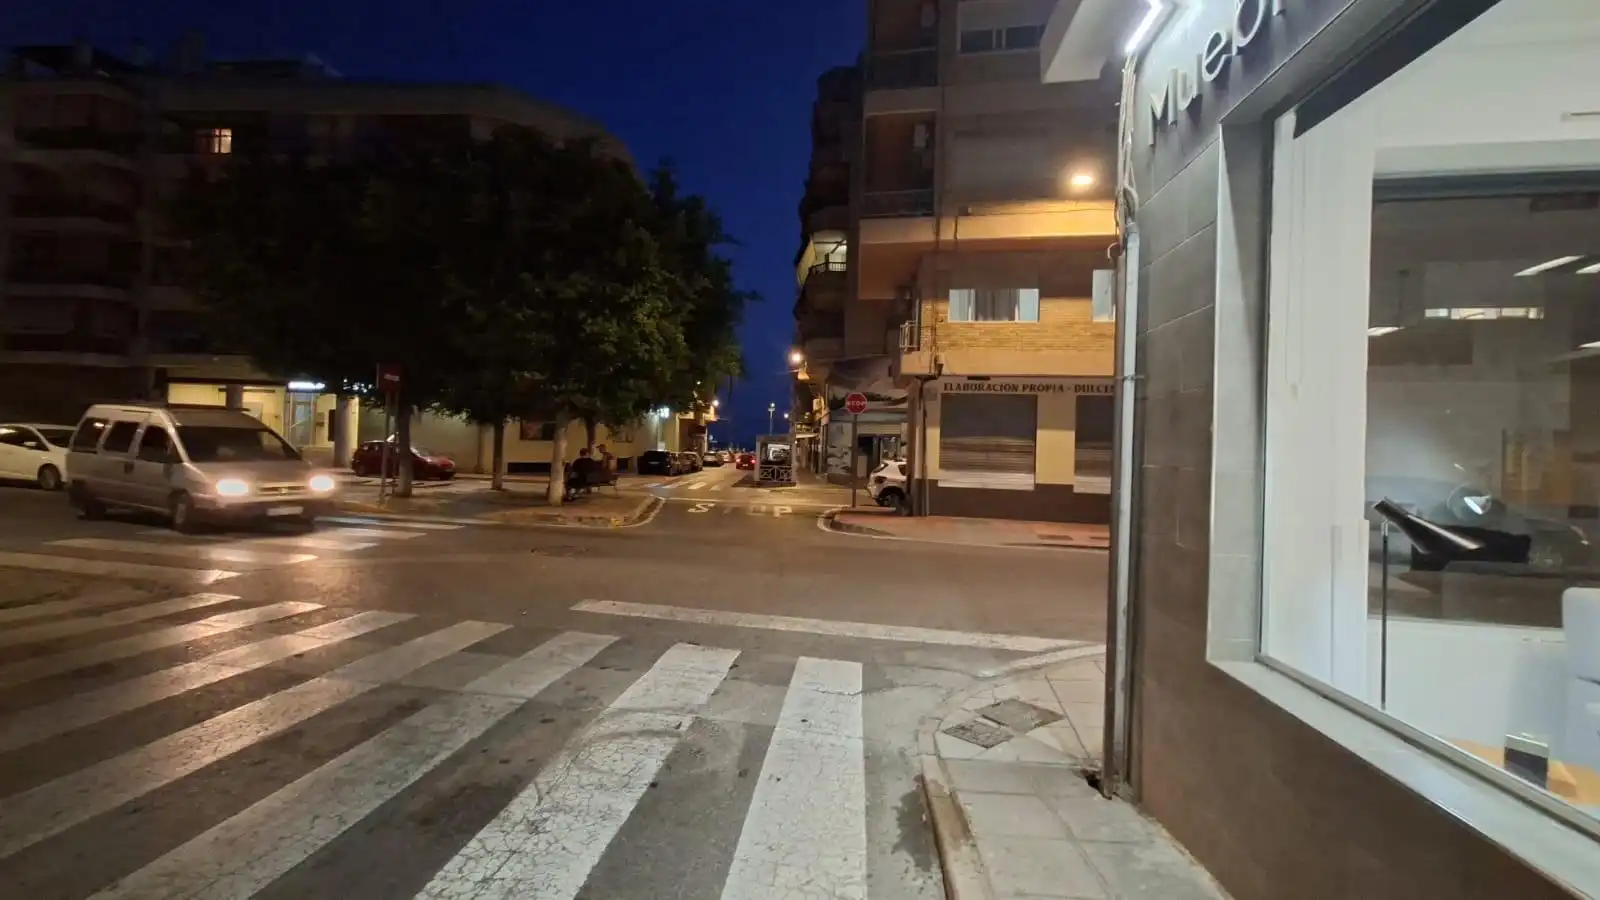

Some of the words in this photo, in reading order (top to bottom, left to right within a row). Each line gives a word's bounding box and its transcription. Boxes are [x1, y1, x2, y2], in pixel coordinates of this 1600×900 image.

[1148, 0, 1284, 146] Mueb
[1022, 383, 1064, 393] PROPIA
[846, 399, 866, 407] STOP
